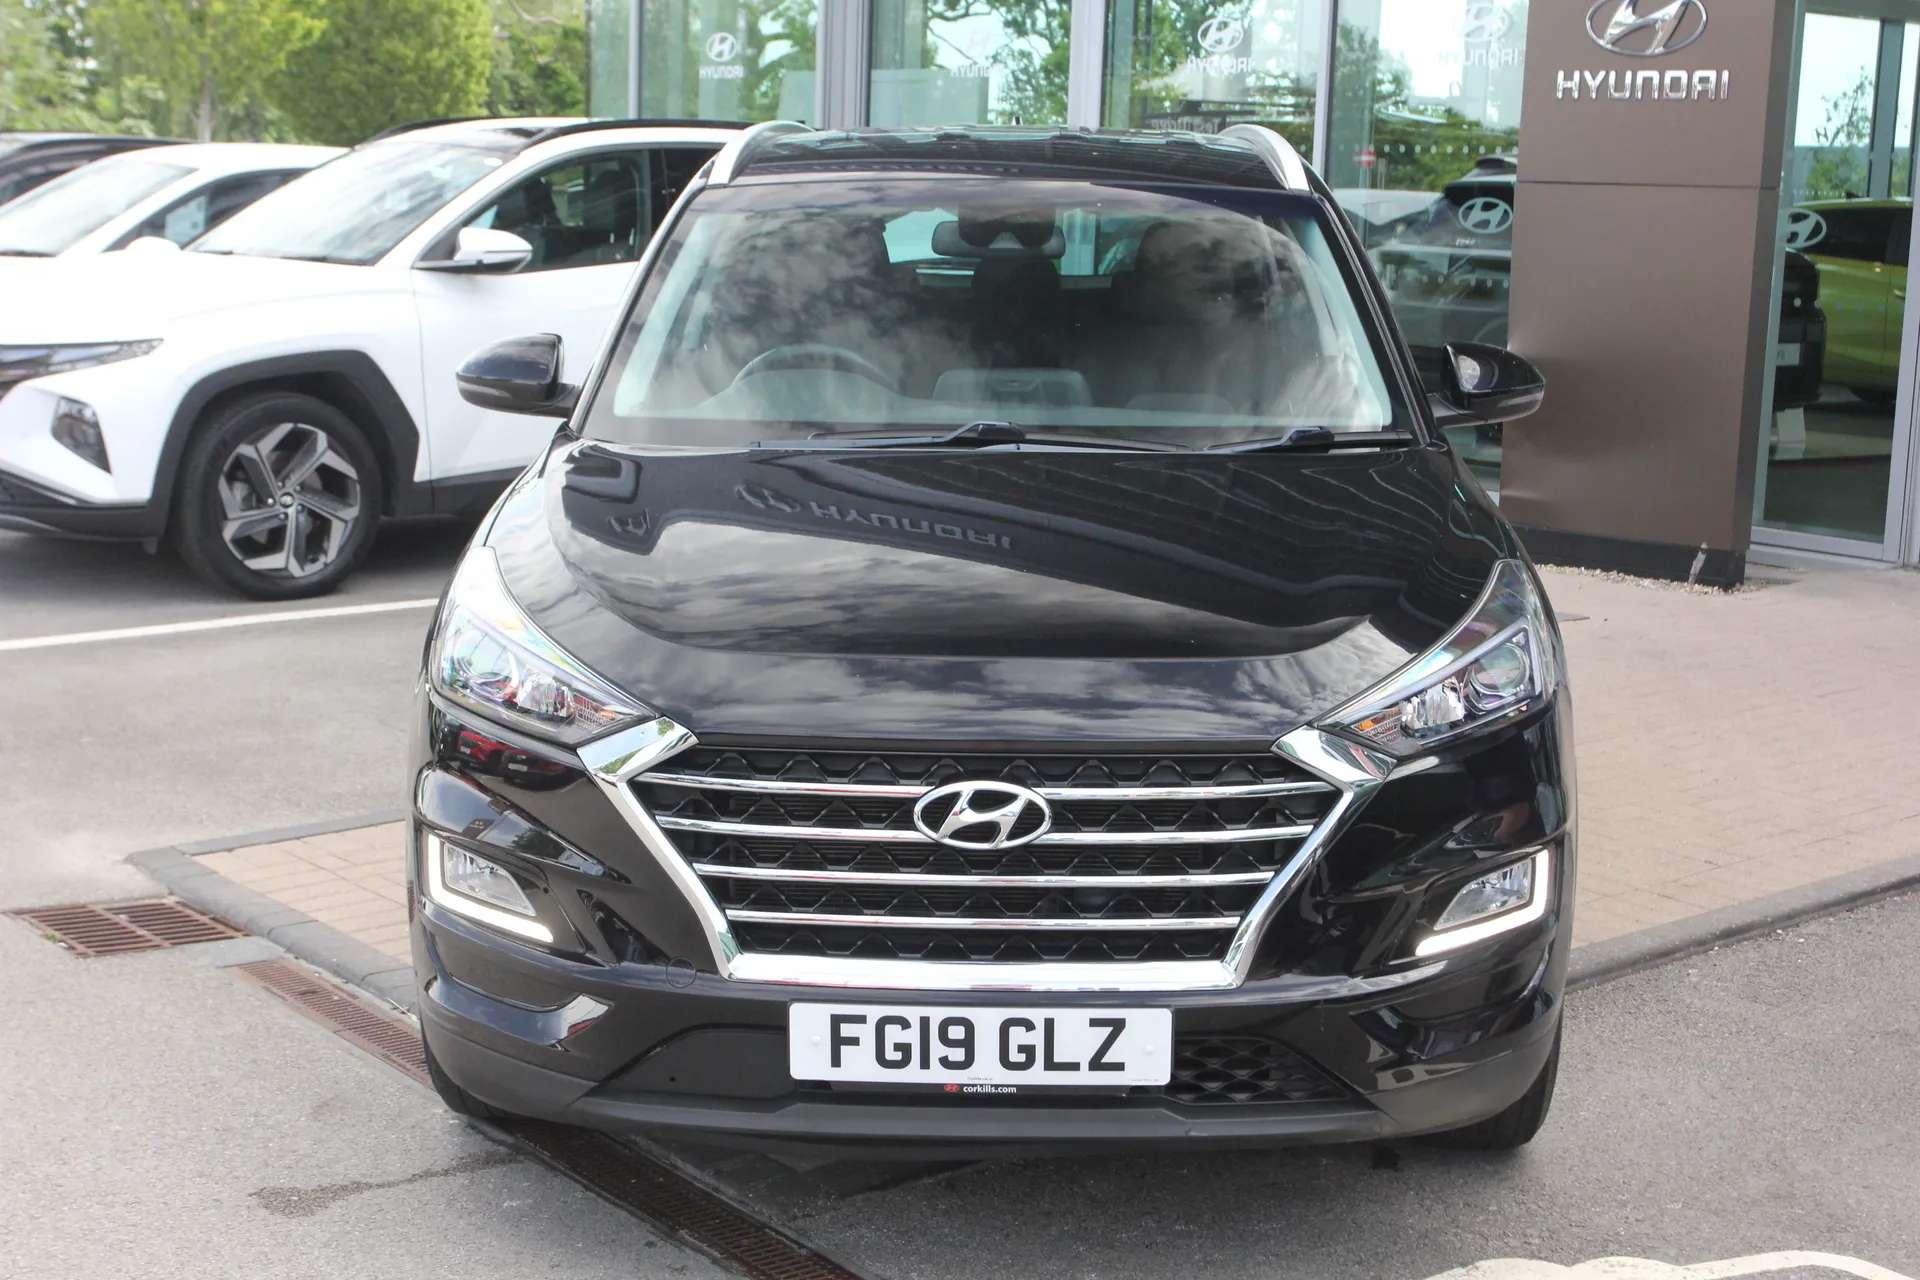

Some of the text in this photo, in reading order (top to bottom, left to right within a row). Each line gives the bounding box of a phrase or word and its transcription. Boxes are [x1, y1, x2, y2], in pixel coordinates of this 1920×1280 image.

[1556, 69, 1729, 100] HYUNDAI
[830, 1013, 1127, 1072] FG19 GLZ
[962, 1084, 1017, 1094] corkills.com
